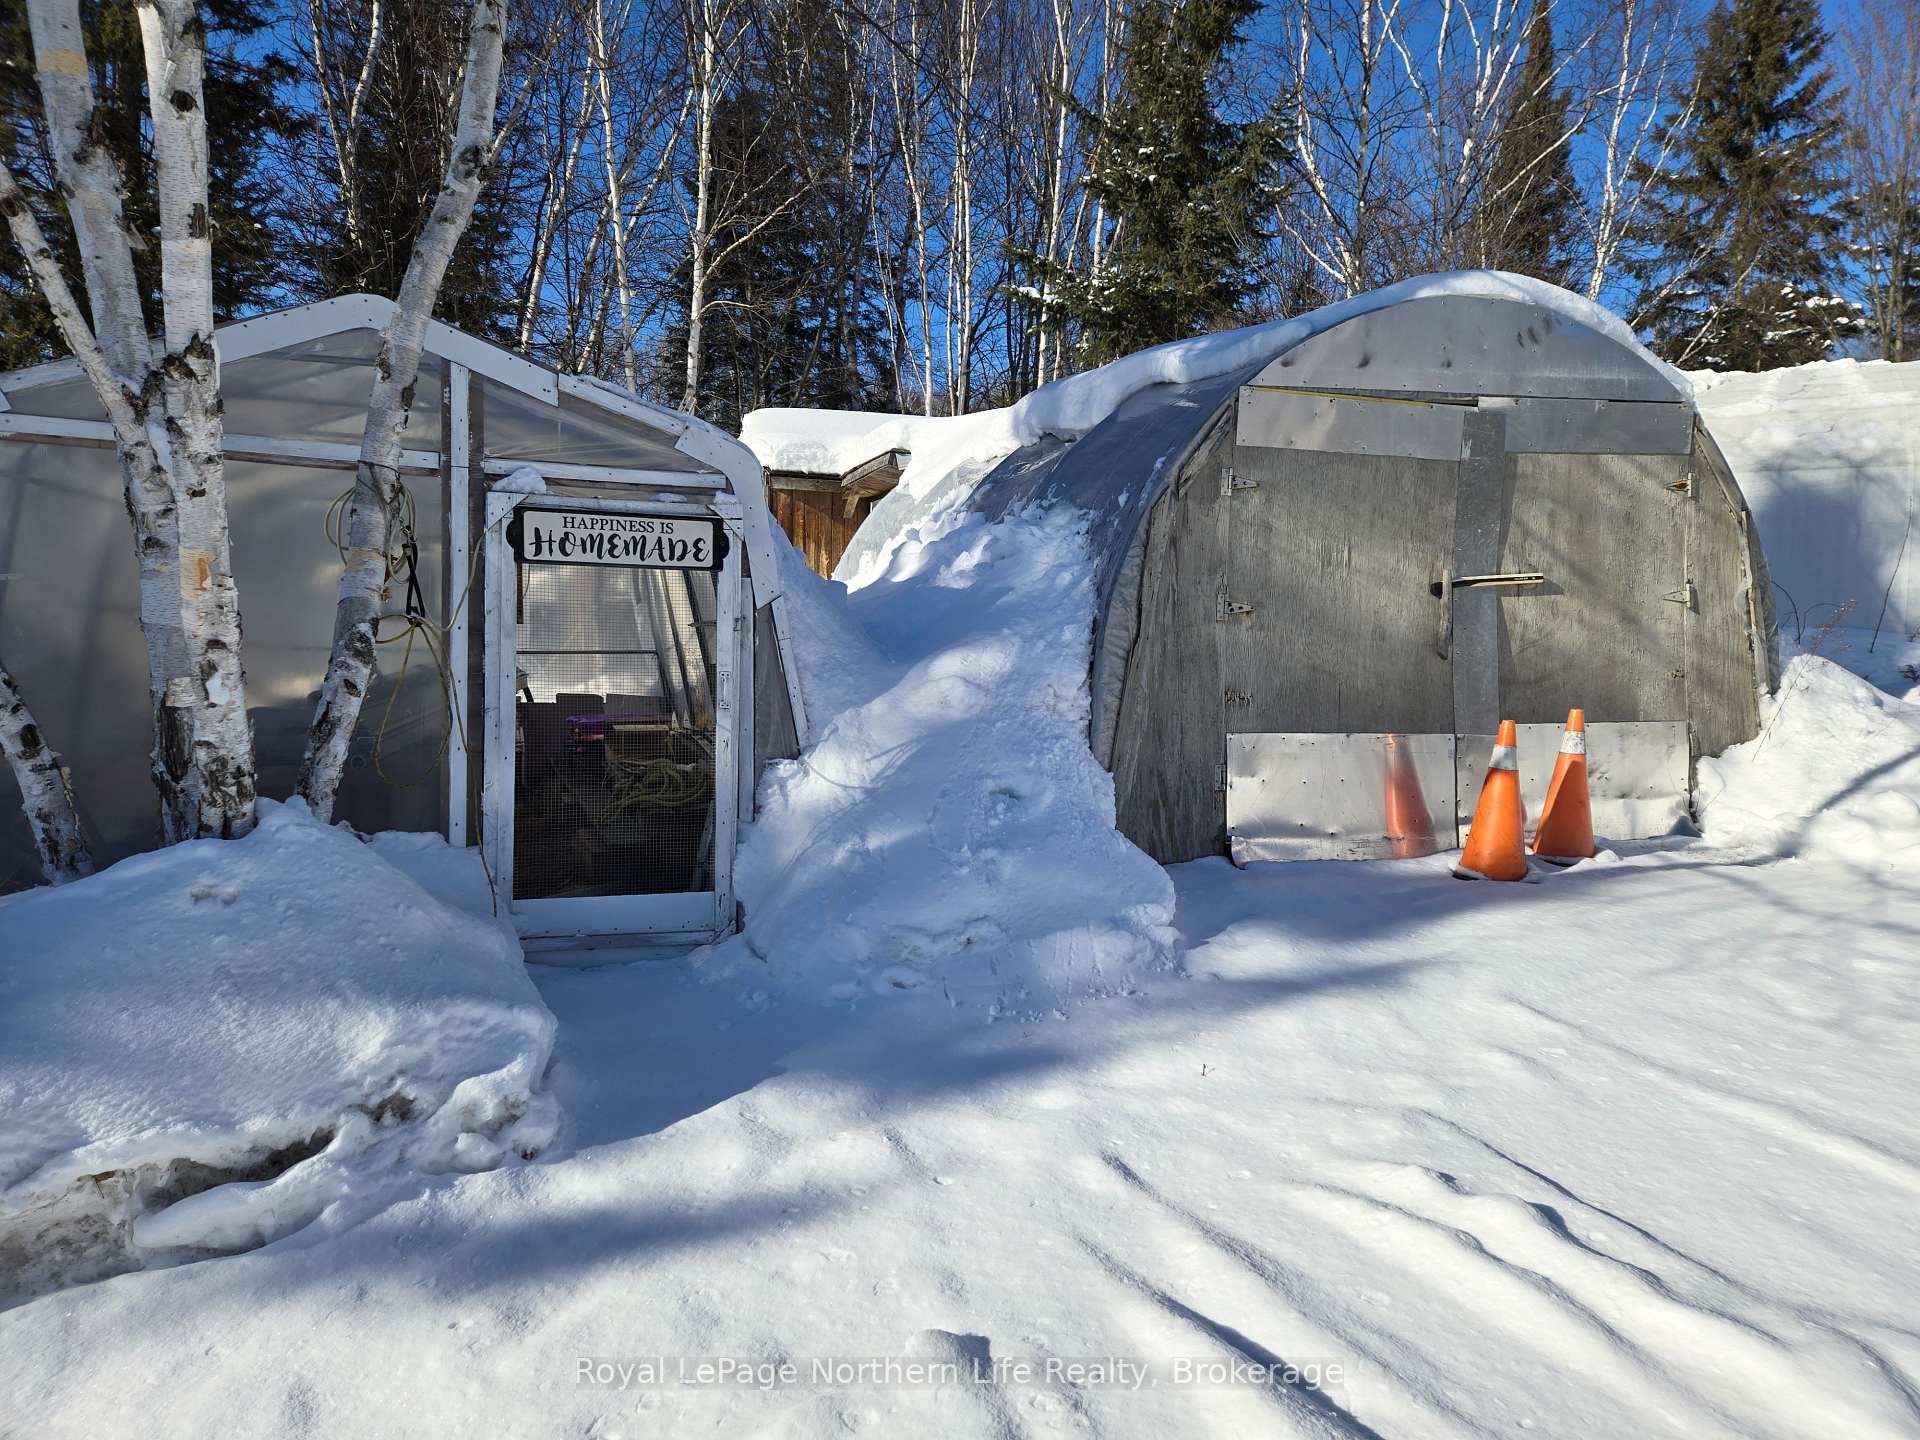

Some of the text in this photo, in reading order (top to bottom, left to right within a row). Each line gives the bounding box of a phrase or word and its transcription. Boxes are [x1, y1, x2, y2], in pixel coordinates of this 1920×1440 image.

[562, 516, 674, 534] HAPPINESS IS
[529, 527, 709, 563] HOMEMADE
